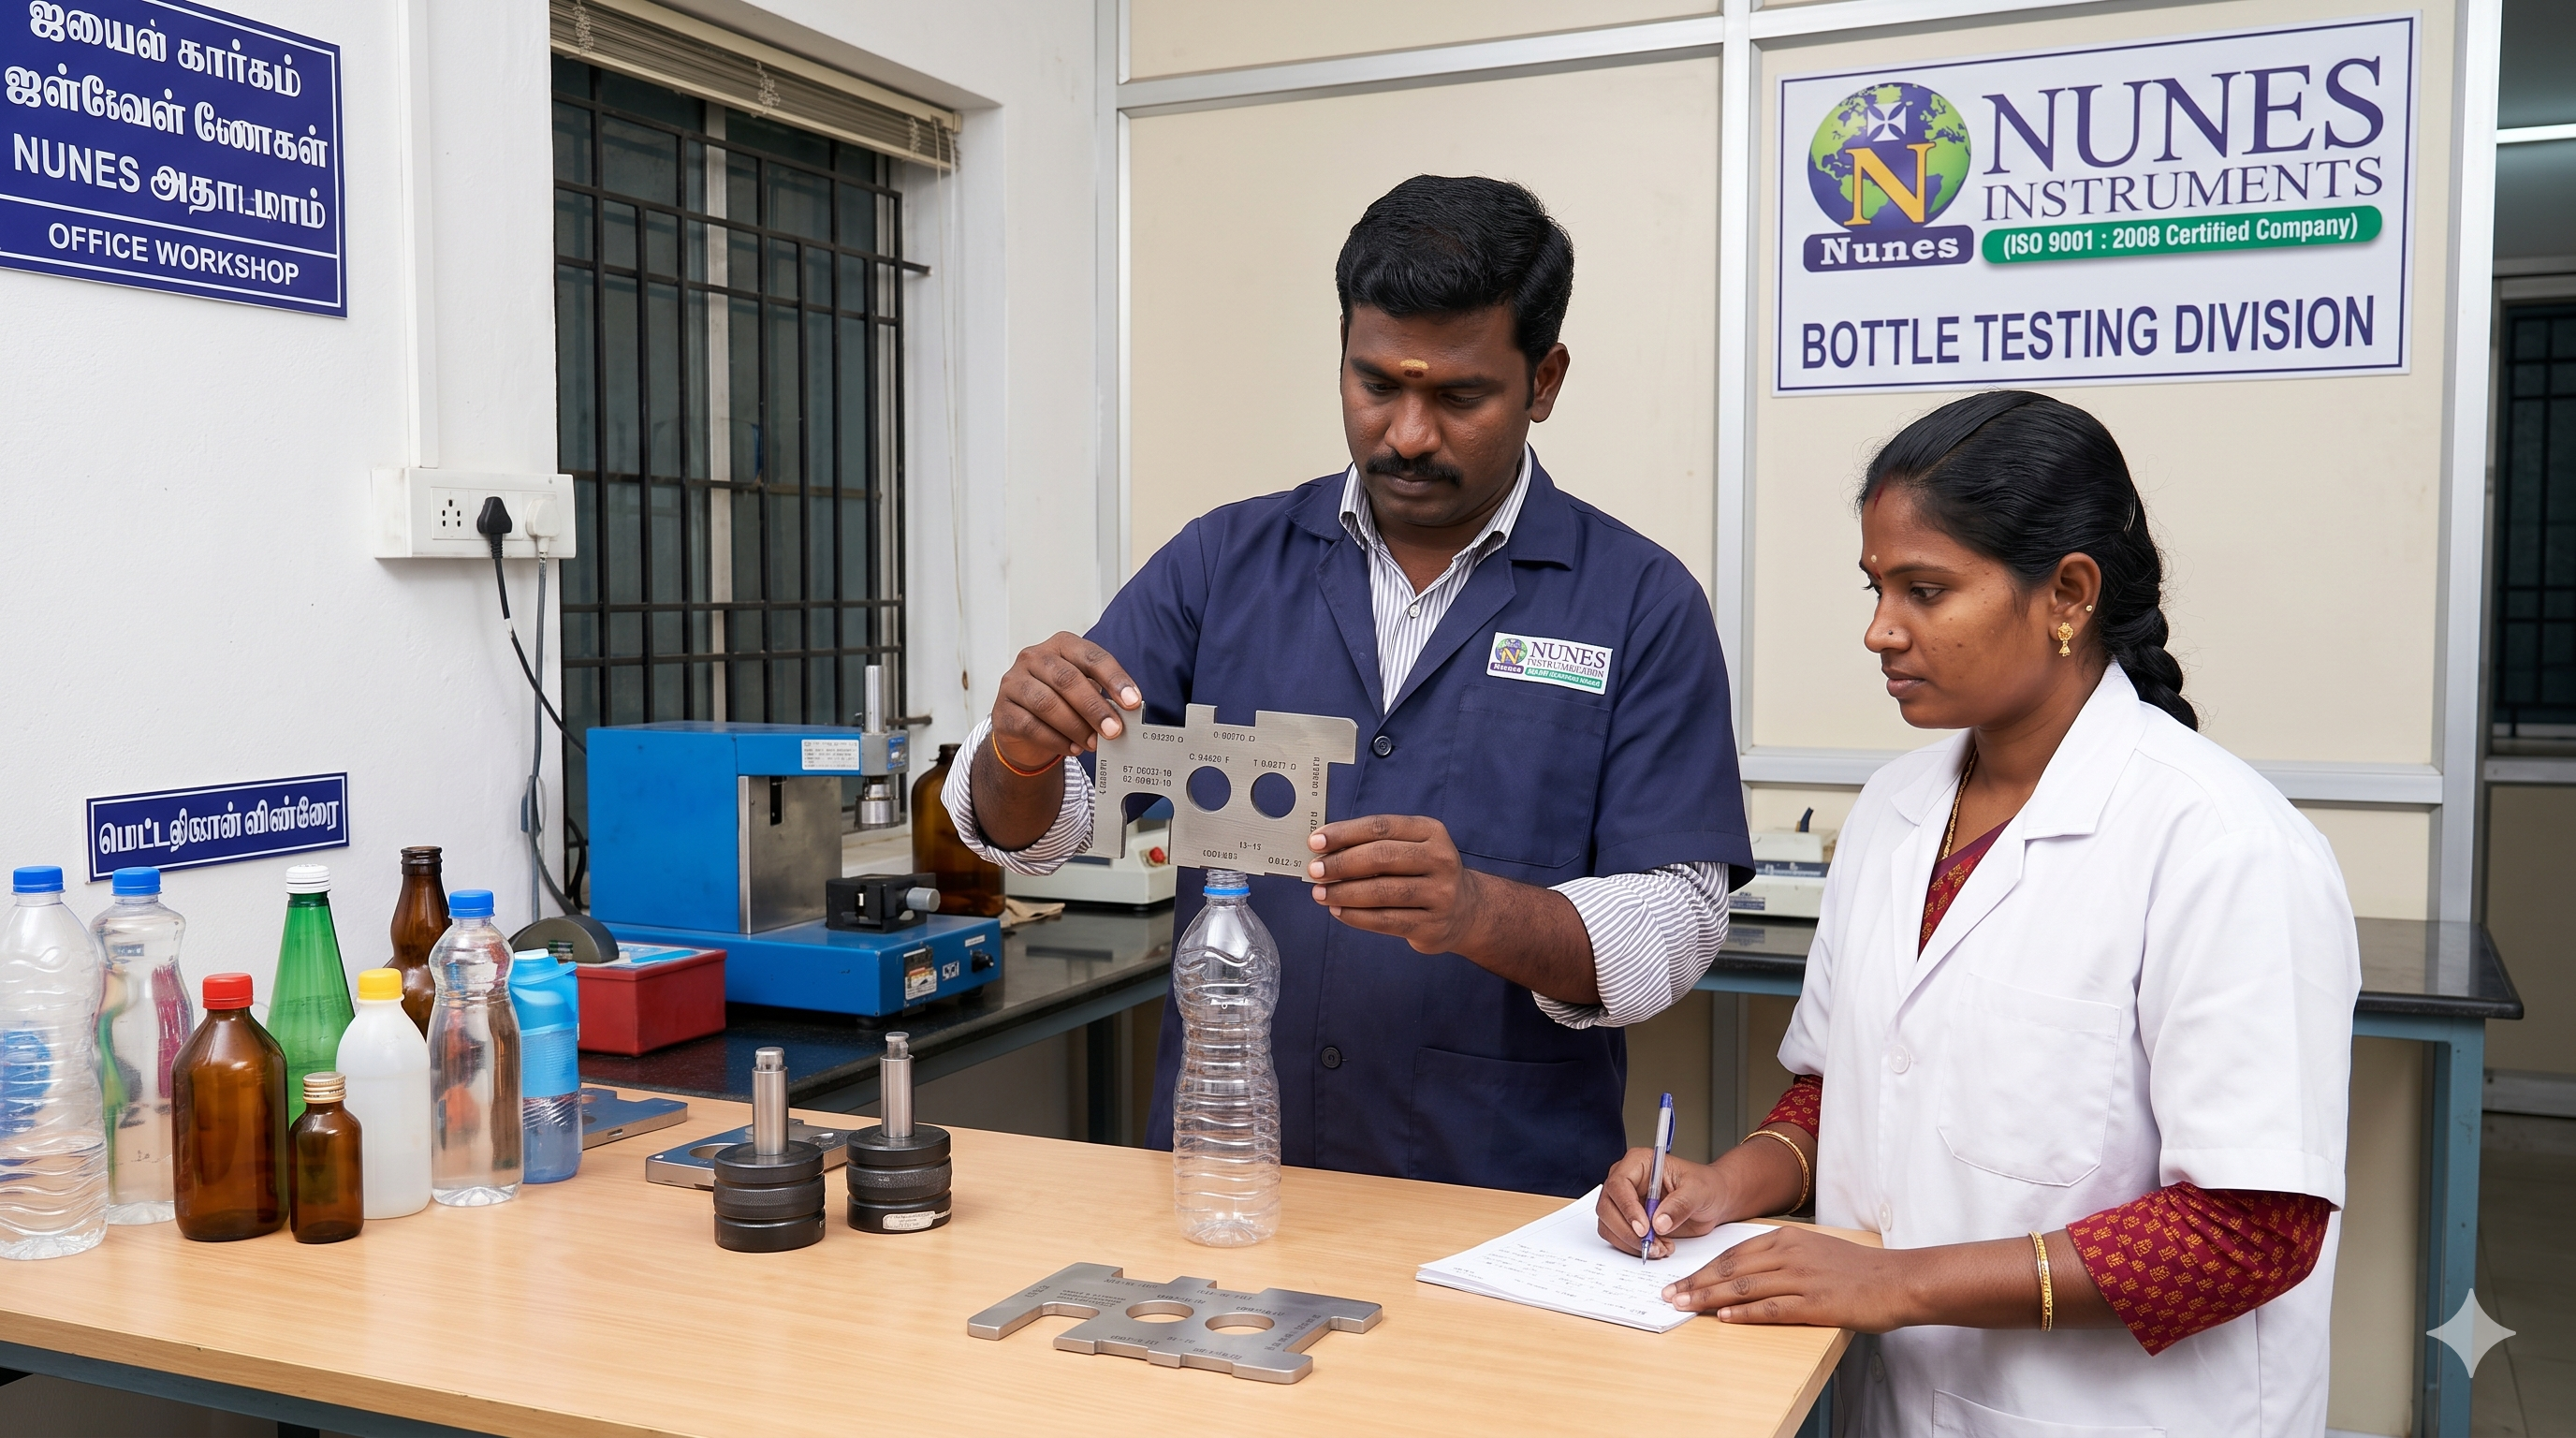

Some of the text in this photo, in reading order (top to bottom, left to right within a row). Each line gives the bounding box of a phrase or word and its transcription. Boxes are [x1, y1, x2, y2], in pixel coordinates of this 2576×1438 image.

[177, 38, 301, 97] கார்கம்
[1981, 55, 2385, 175] NUNES
[13, 133, 140, 193] NUNES
[1843, 141, 1937, 227] N
[1981, 155, 2383, 222] INSTRUMENTS
[49, 222, 300, 286] OFFICE WORKSHOP
[1821, 235, 1960, 266] Nunes
[2002, 232, 2043, 260] (ISO
[2048, 229, 2094, 253] 9001
[2112, 224, 2161, 249] 2008
[2165, 219, 2250, 245] Certified
[2256, 212, 2359, 242] Company)
[1802, 295, 2375, 370] BOTTLE TESTING DIVISION
[1530, 641, 1606, 669] NUNES
